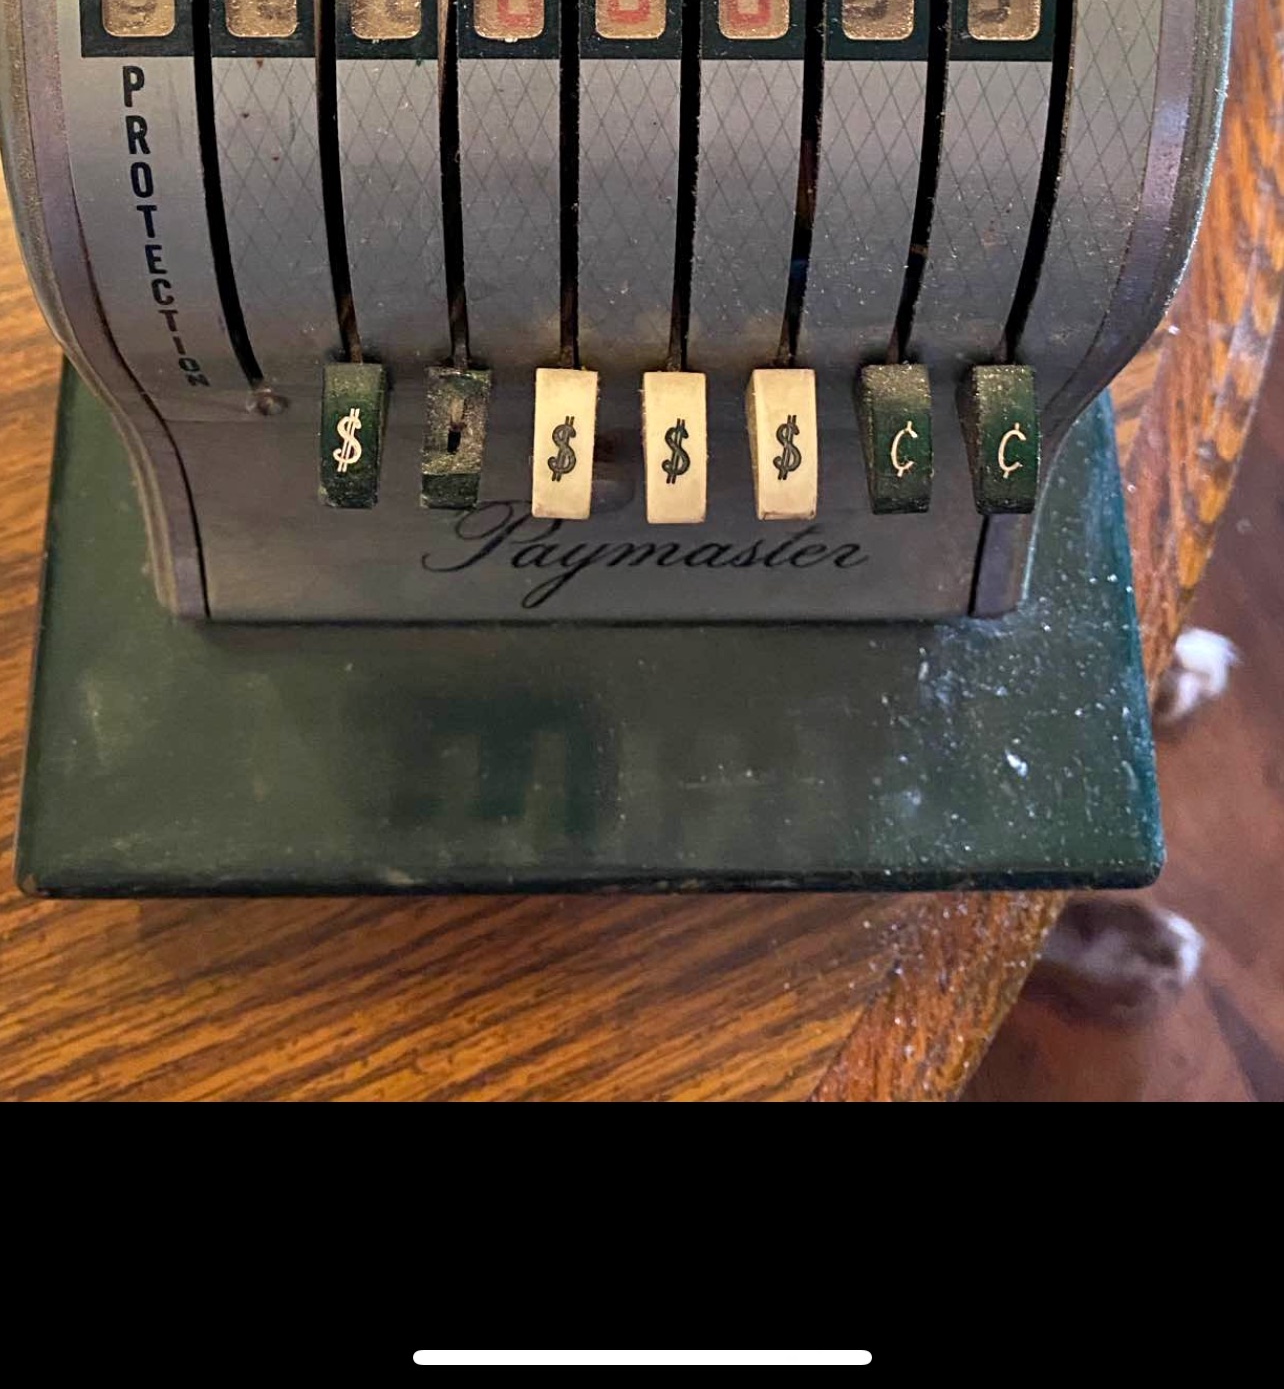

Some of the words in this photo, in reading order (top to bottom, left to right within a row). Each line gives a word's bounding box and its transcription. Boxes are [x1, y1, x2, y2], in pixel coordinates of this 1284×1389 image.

[122, 65, 210, 388] PROTECTION
[333, 407, 363, 473] $
[546, 415, 578, 482] $
[663, 417, 691, 484] $
[773, 414, 803, 481] $
[421, 499, 870, 609] Paymaster
